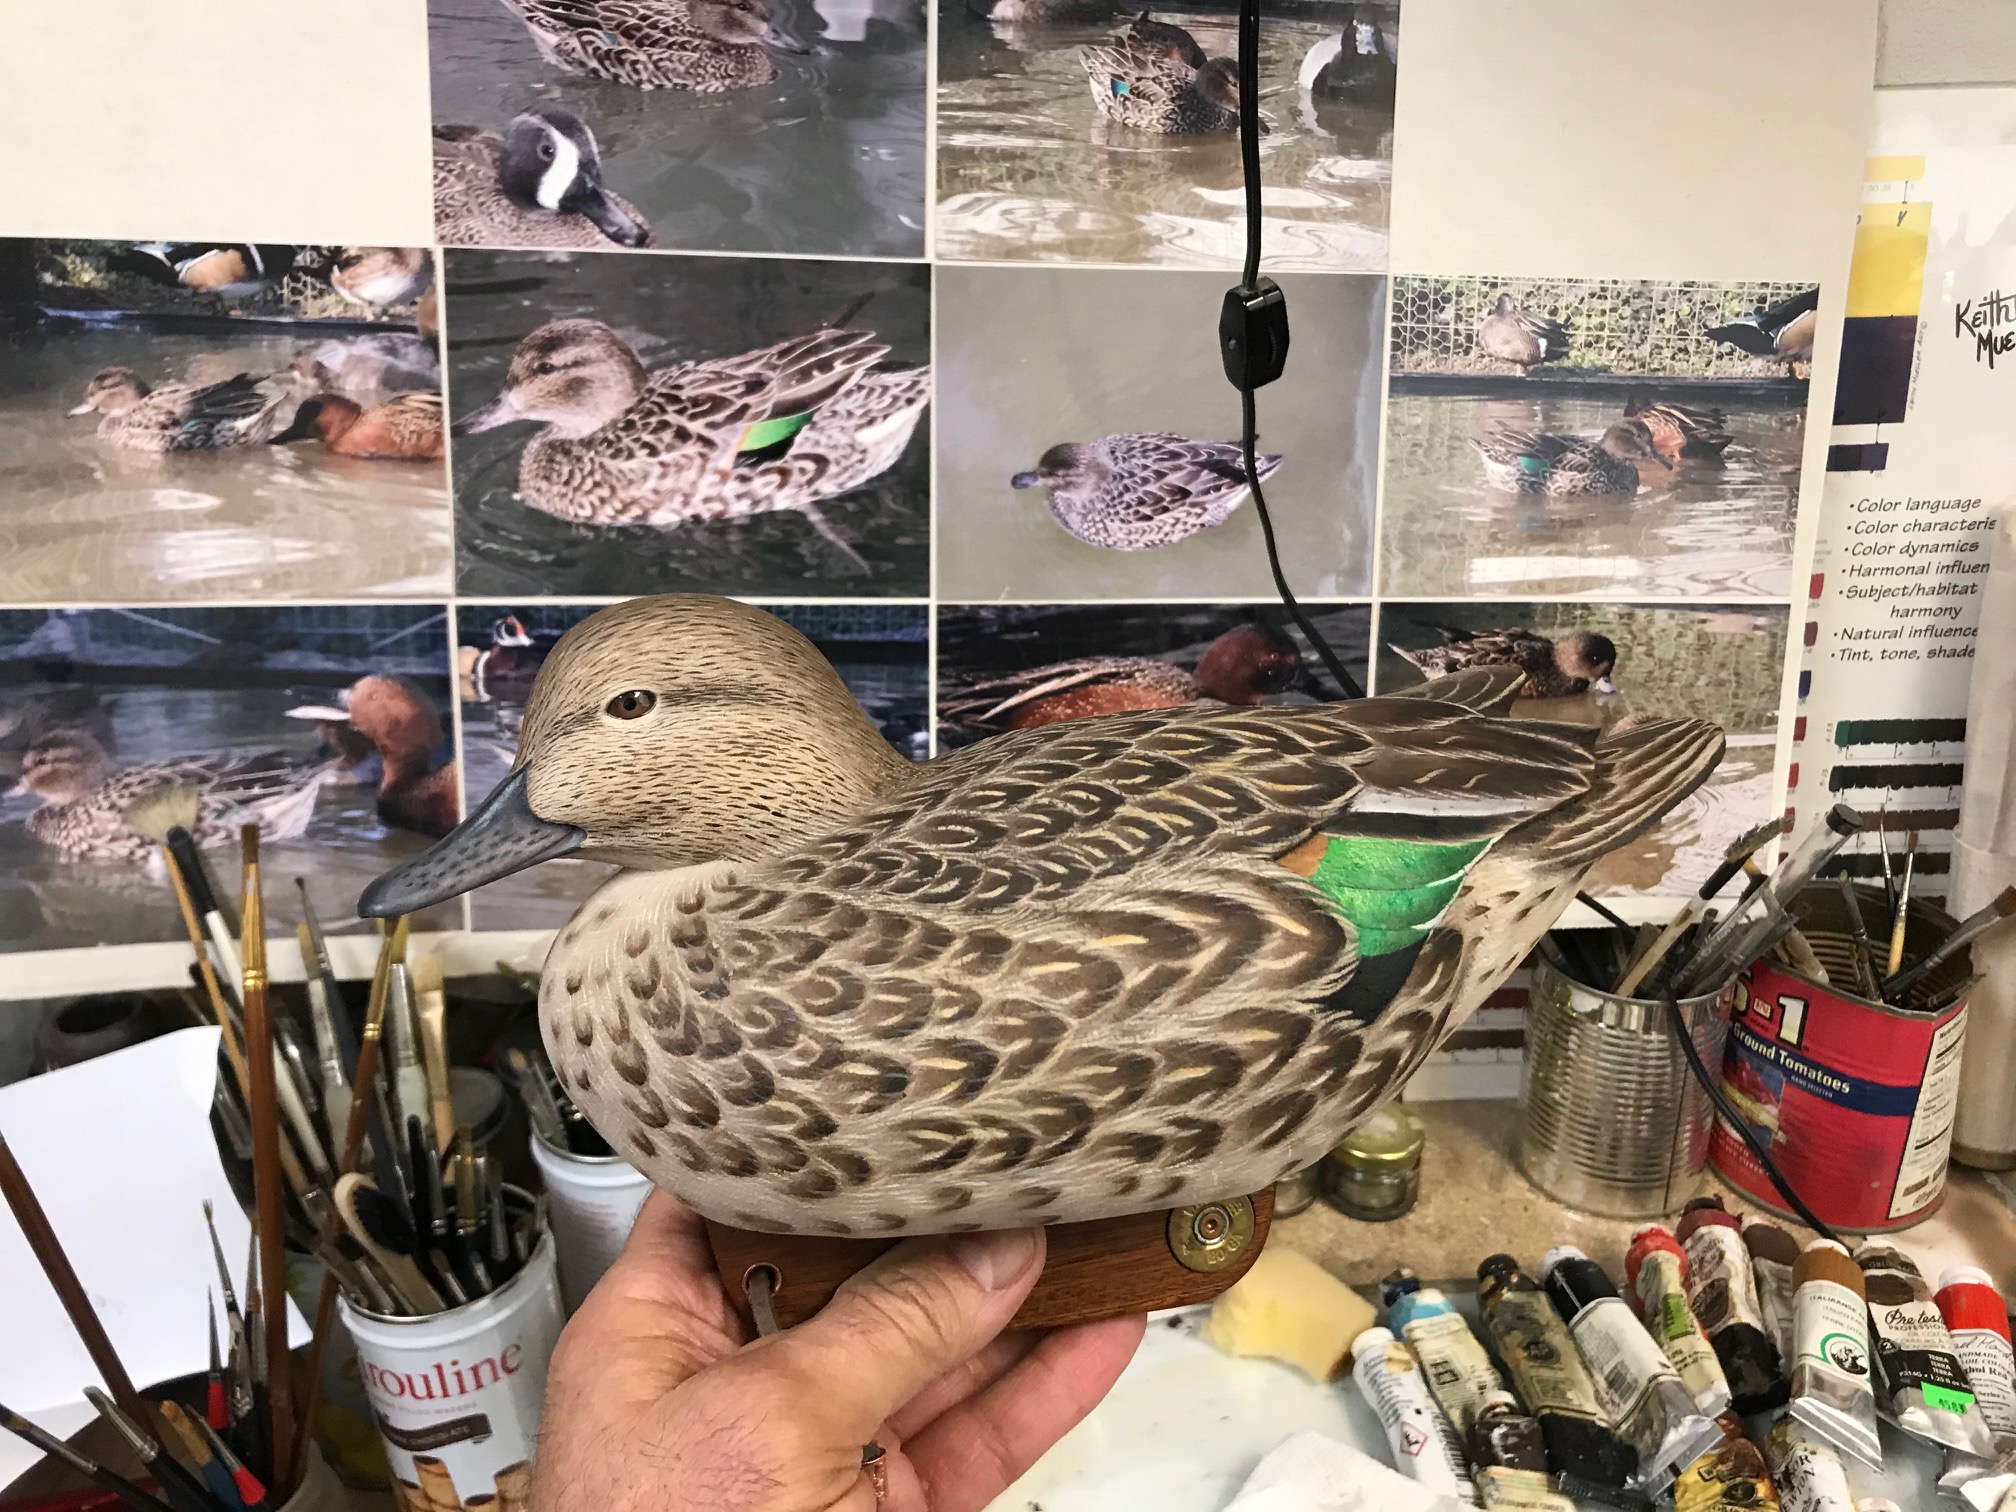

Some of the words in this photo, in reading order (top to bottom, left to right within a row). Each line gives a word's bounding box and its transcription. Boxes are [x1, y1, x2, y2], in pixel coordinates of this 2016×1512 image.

[1955, 289, 2014, 339] Keith
[1857, 497, 1901, 513] Color
[1905, 497, 1982, 513] language
[1854, 520, 1898, 535] Color
[1851, 541, 1895, 556] Color
[1899, 539, 1979, 557] dynamics
[1849, 561, 1931, 578] Harmonal
[1846, 582, 1978, 602] Subject/habitat
[1890, 605, 1963, 620] harmony
[1841, 625, 1904, 641] Natural
[1839, 647, 1873, 662] Tint,
[1880, 648, 1920, 660] tone,
[1777, 994, 1807, 1048] 1
[1733, 1020, 1776, 1061] Ground
[1779, 1048, 1850, 1094] Tomatoes
[1928, 1354, 1949, 1363] TERRA
[1930, 1361, 1952, 1370] TERRA
[1932, 1367, 1954, 1377] TERRA
[1989, 1368, 2008, 1380] Red
